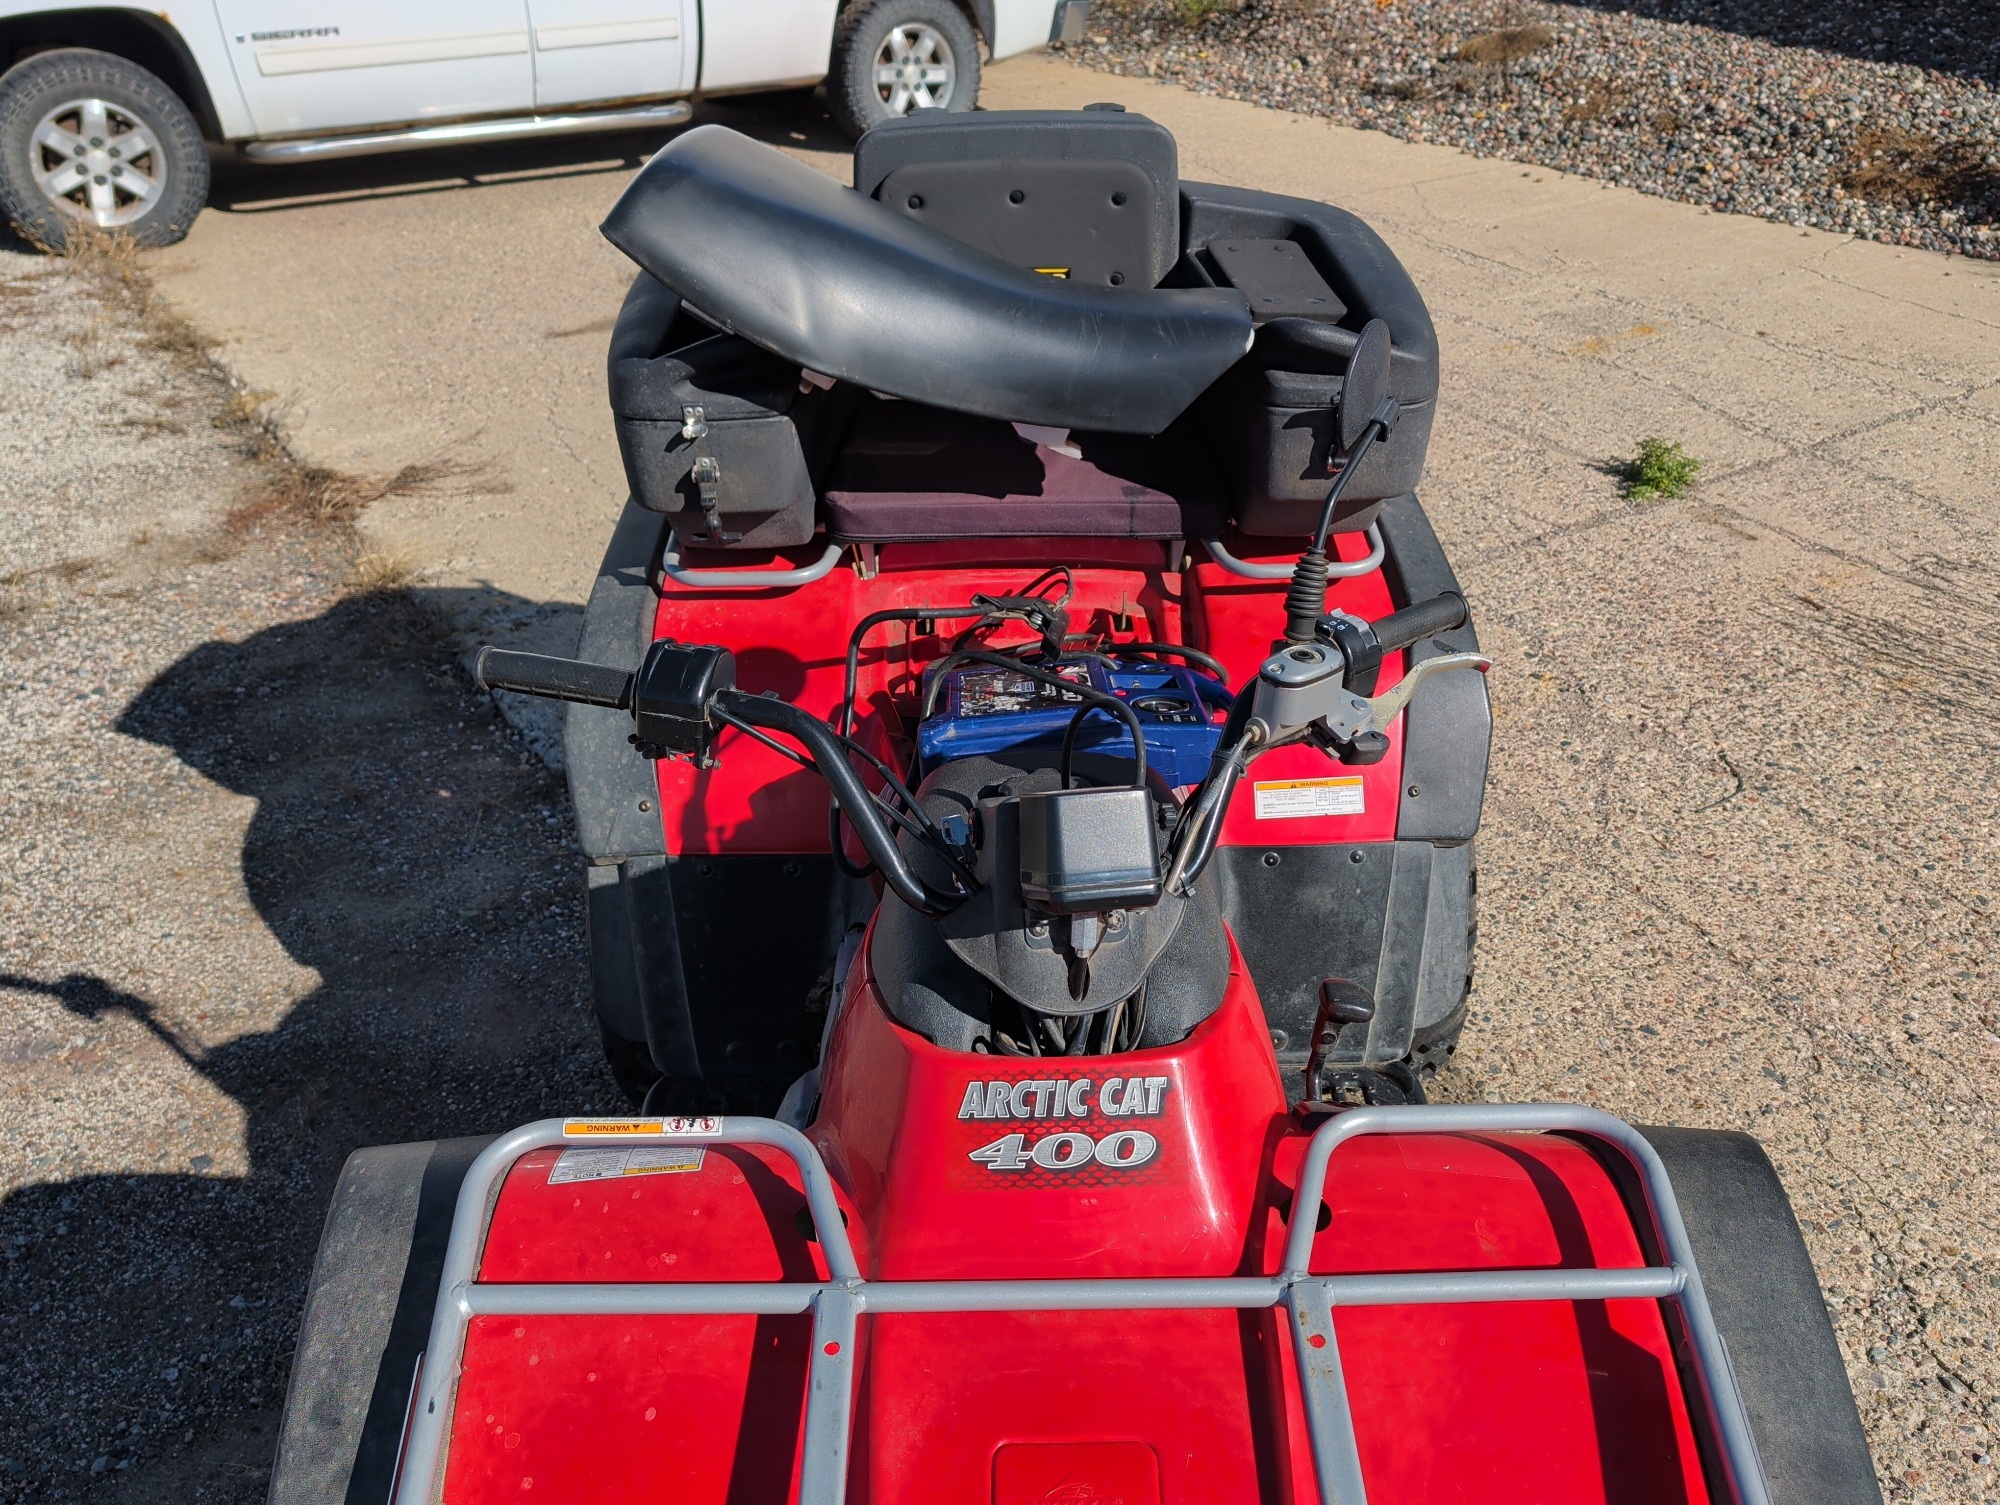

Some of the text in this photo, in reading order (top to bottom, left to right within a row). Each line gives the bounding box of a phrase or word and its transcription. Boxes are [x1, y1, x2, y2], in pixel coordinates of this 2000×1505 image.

[251, 26, 340, 42] SIERRA
[957, 1076, 1169, 1119] ARCTIC CAT
[586, 1124, 630, 1132] WARNING
[967, 1130, 1157, 1169] 400
[637, 1165, 676, 1173] WARNING
